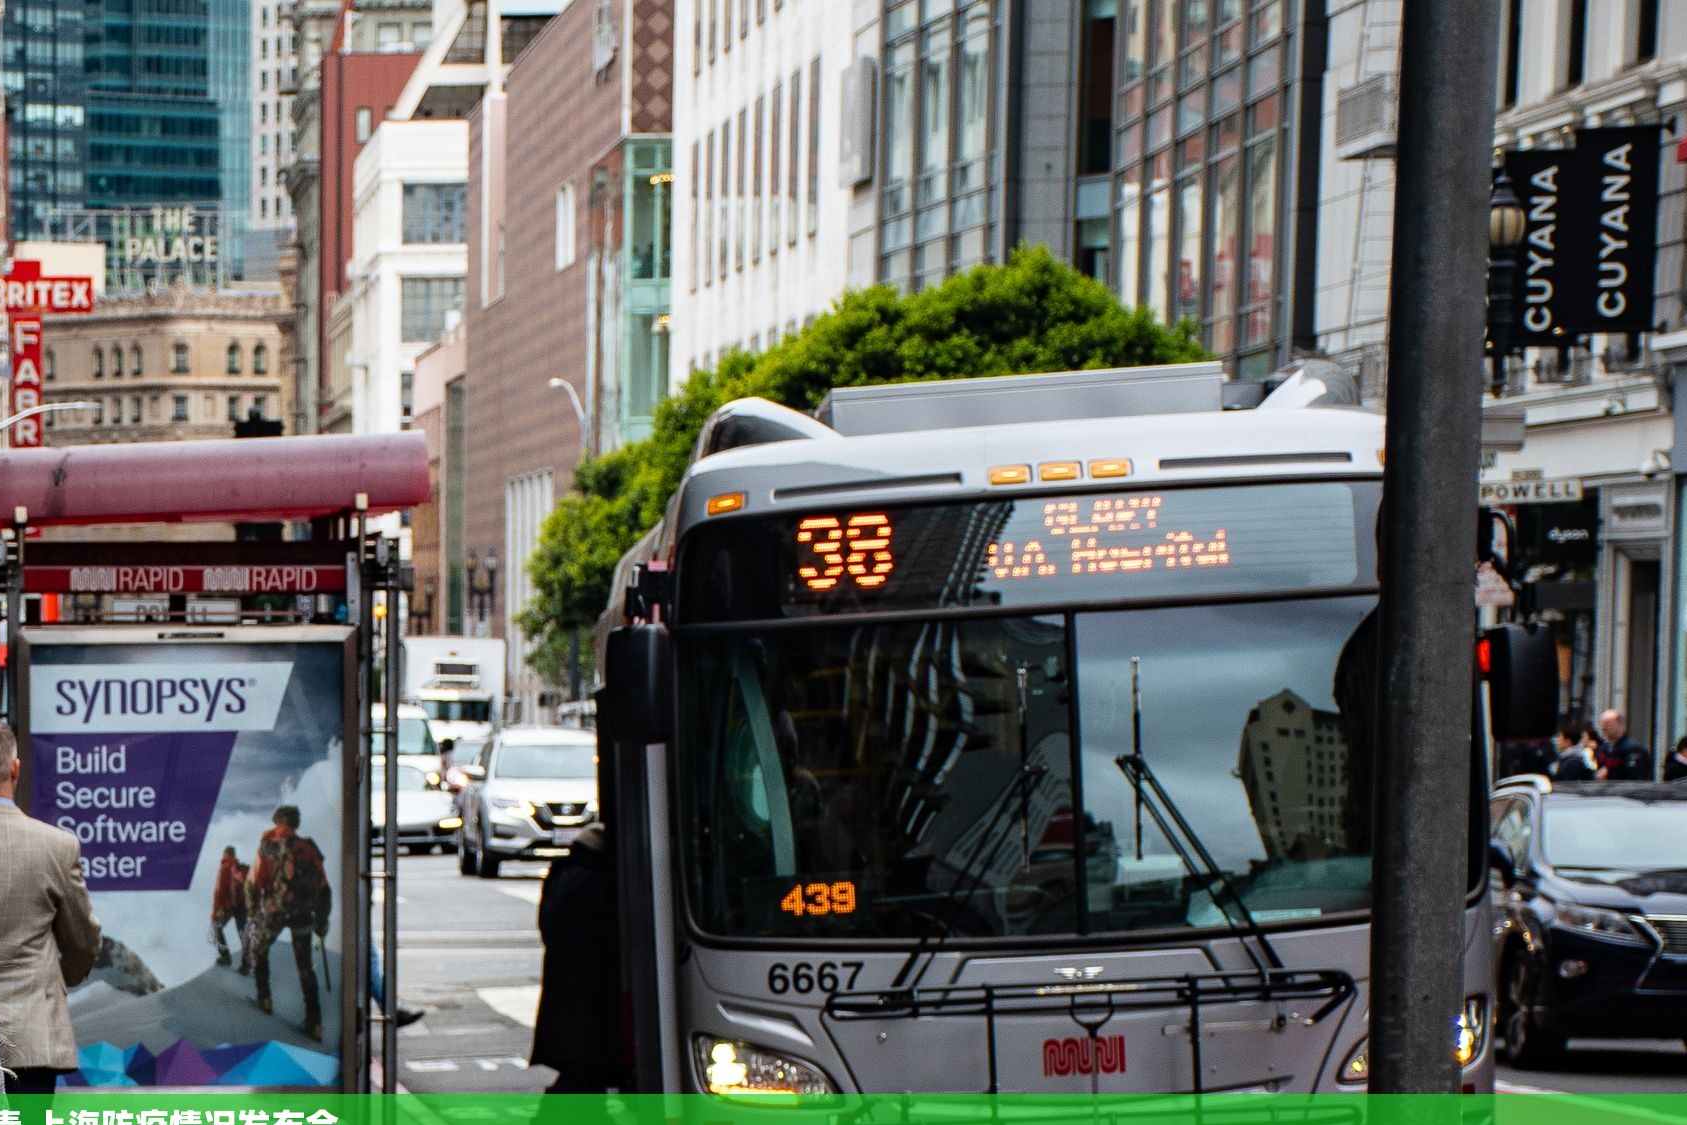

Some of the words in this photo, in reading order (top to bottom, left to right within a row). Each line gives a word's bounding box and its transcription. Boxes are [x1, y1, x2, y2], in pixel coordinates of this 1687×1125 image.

[153, 206, 196, 232] THE
[1596, 142, 1633, 318] CUYANA
[126, 235, 218, 262] PALACE
[1523, 165, 1559, 333] CUYANA
[1481, 482, 1575, 499] POWELL
[797, 513, 893, 590] 38
[118, 566, 184, 592] RAPID
[251, 566, 317, 592] RAPID
[56, 745, 126, 774] Build
[56, 781, 156, 808] Secure
[79, 852, 147, 878] aster
[781, 881, 856, 916] 439
[768, 961, 864, 994] 6667
